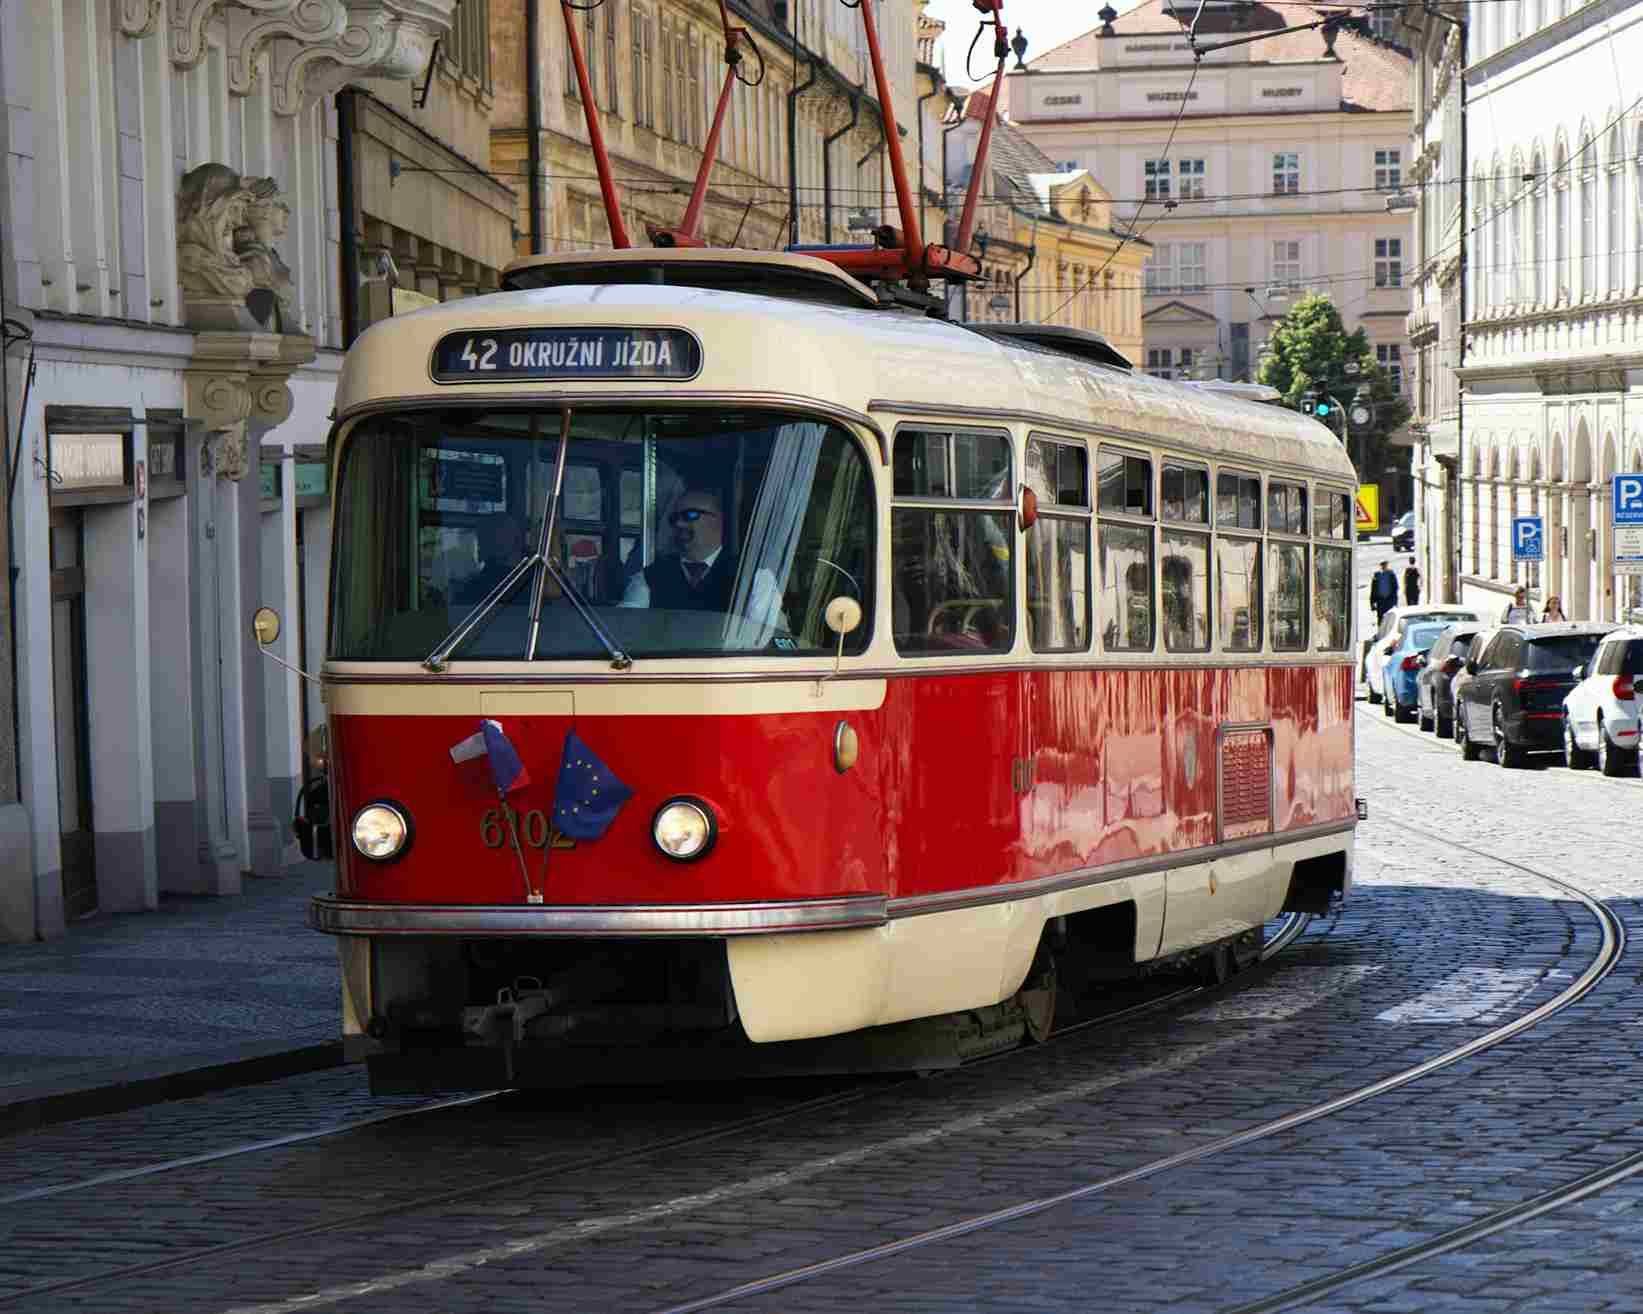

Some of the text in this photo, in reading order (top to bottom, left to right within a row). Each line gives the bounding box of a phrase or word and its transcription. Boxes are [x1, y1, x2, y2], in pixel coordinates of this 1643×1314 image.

[461, 335, 673, 370] 42 OKRUŽNÍ JÍZDA
[1620, 480, 1641, 509] P
[1519, 522, 1537, 548] P
